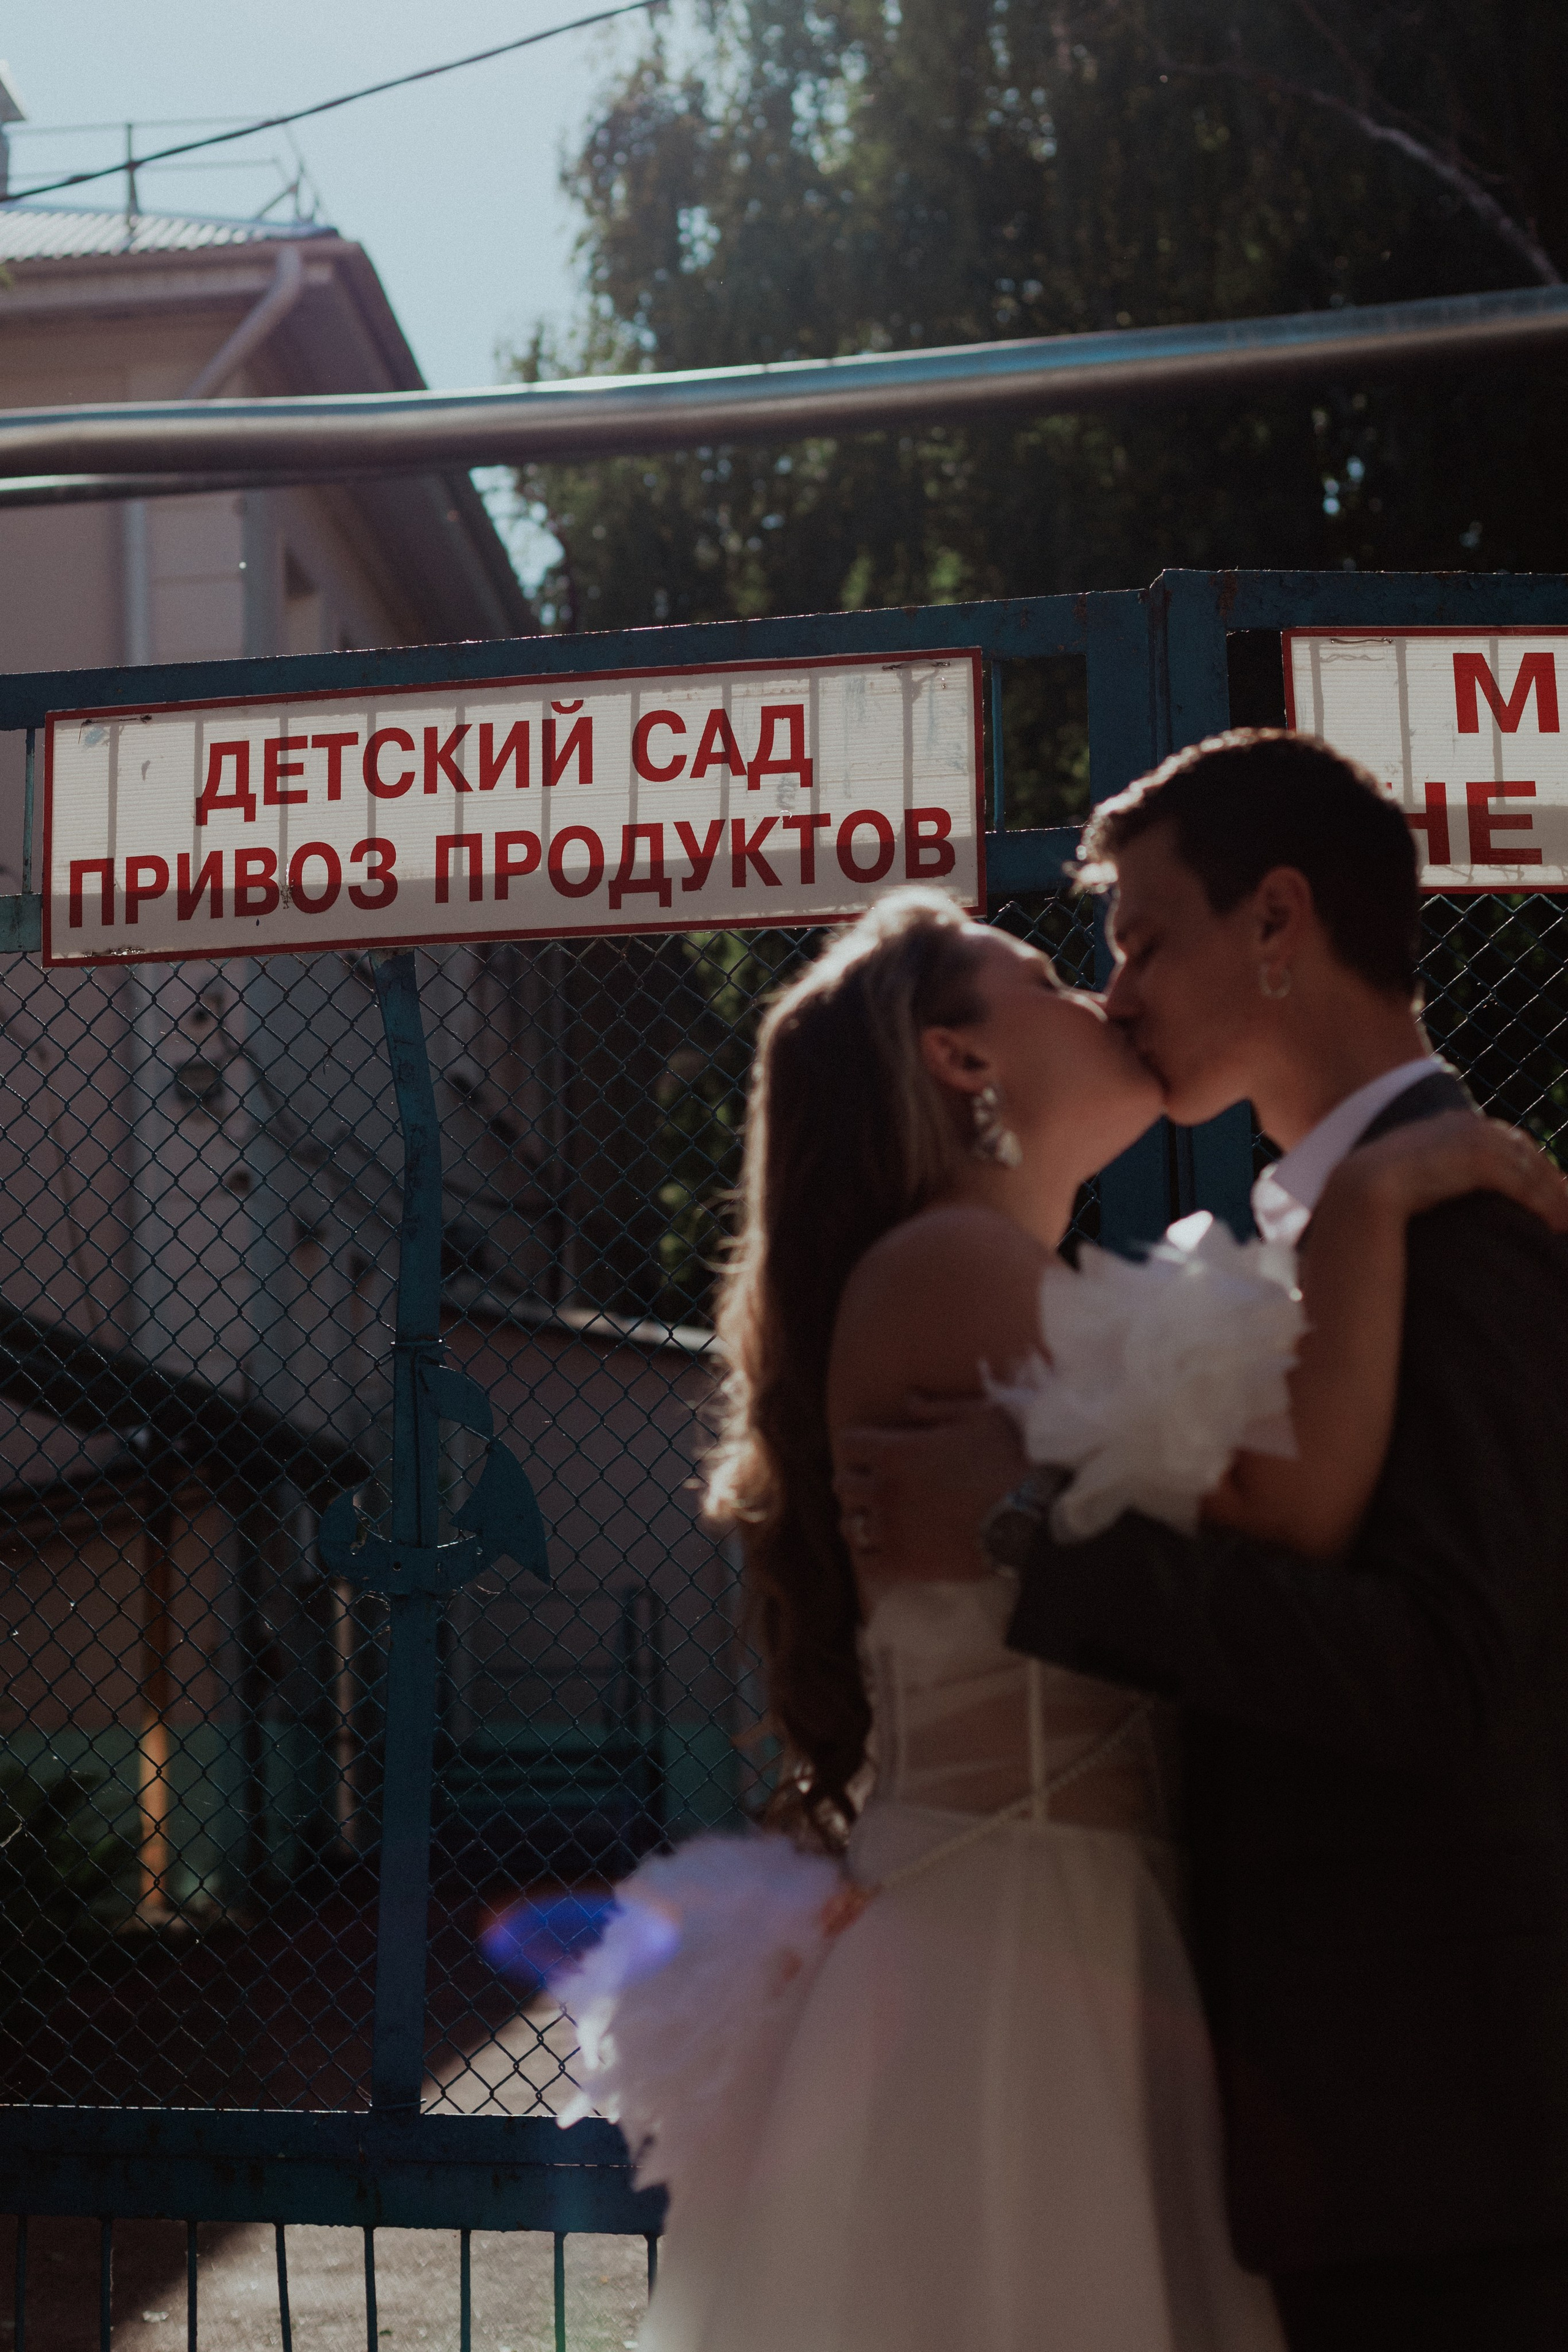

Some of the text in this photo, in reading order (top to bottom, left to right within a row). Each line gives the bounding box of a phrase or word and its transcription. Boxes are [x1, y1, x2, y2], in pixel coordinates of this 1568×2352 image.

[196, 700, 813, 826] ДЕТСКИЙ САД
[69, 807, 956, 927] ПРИВОЗ ПРОДУКТОВ
